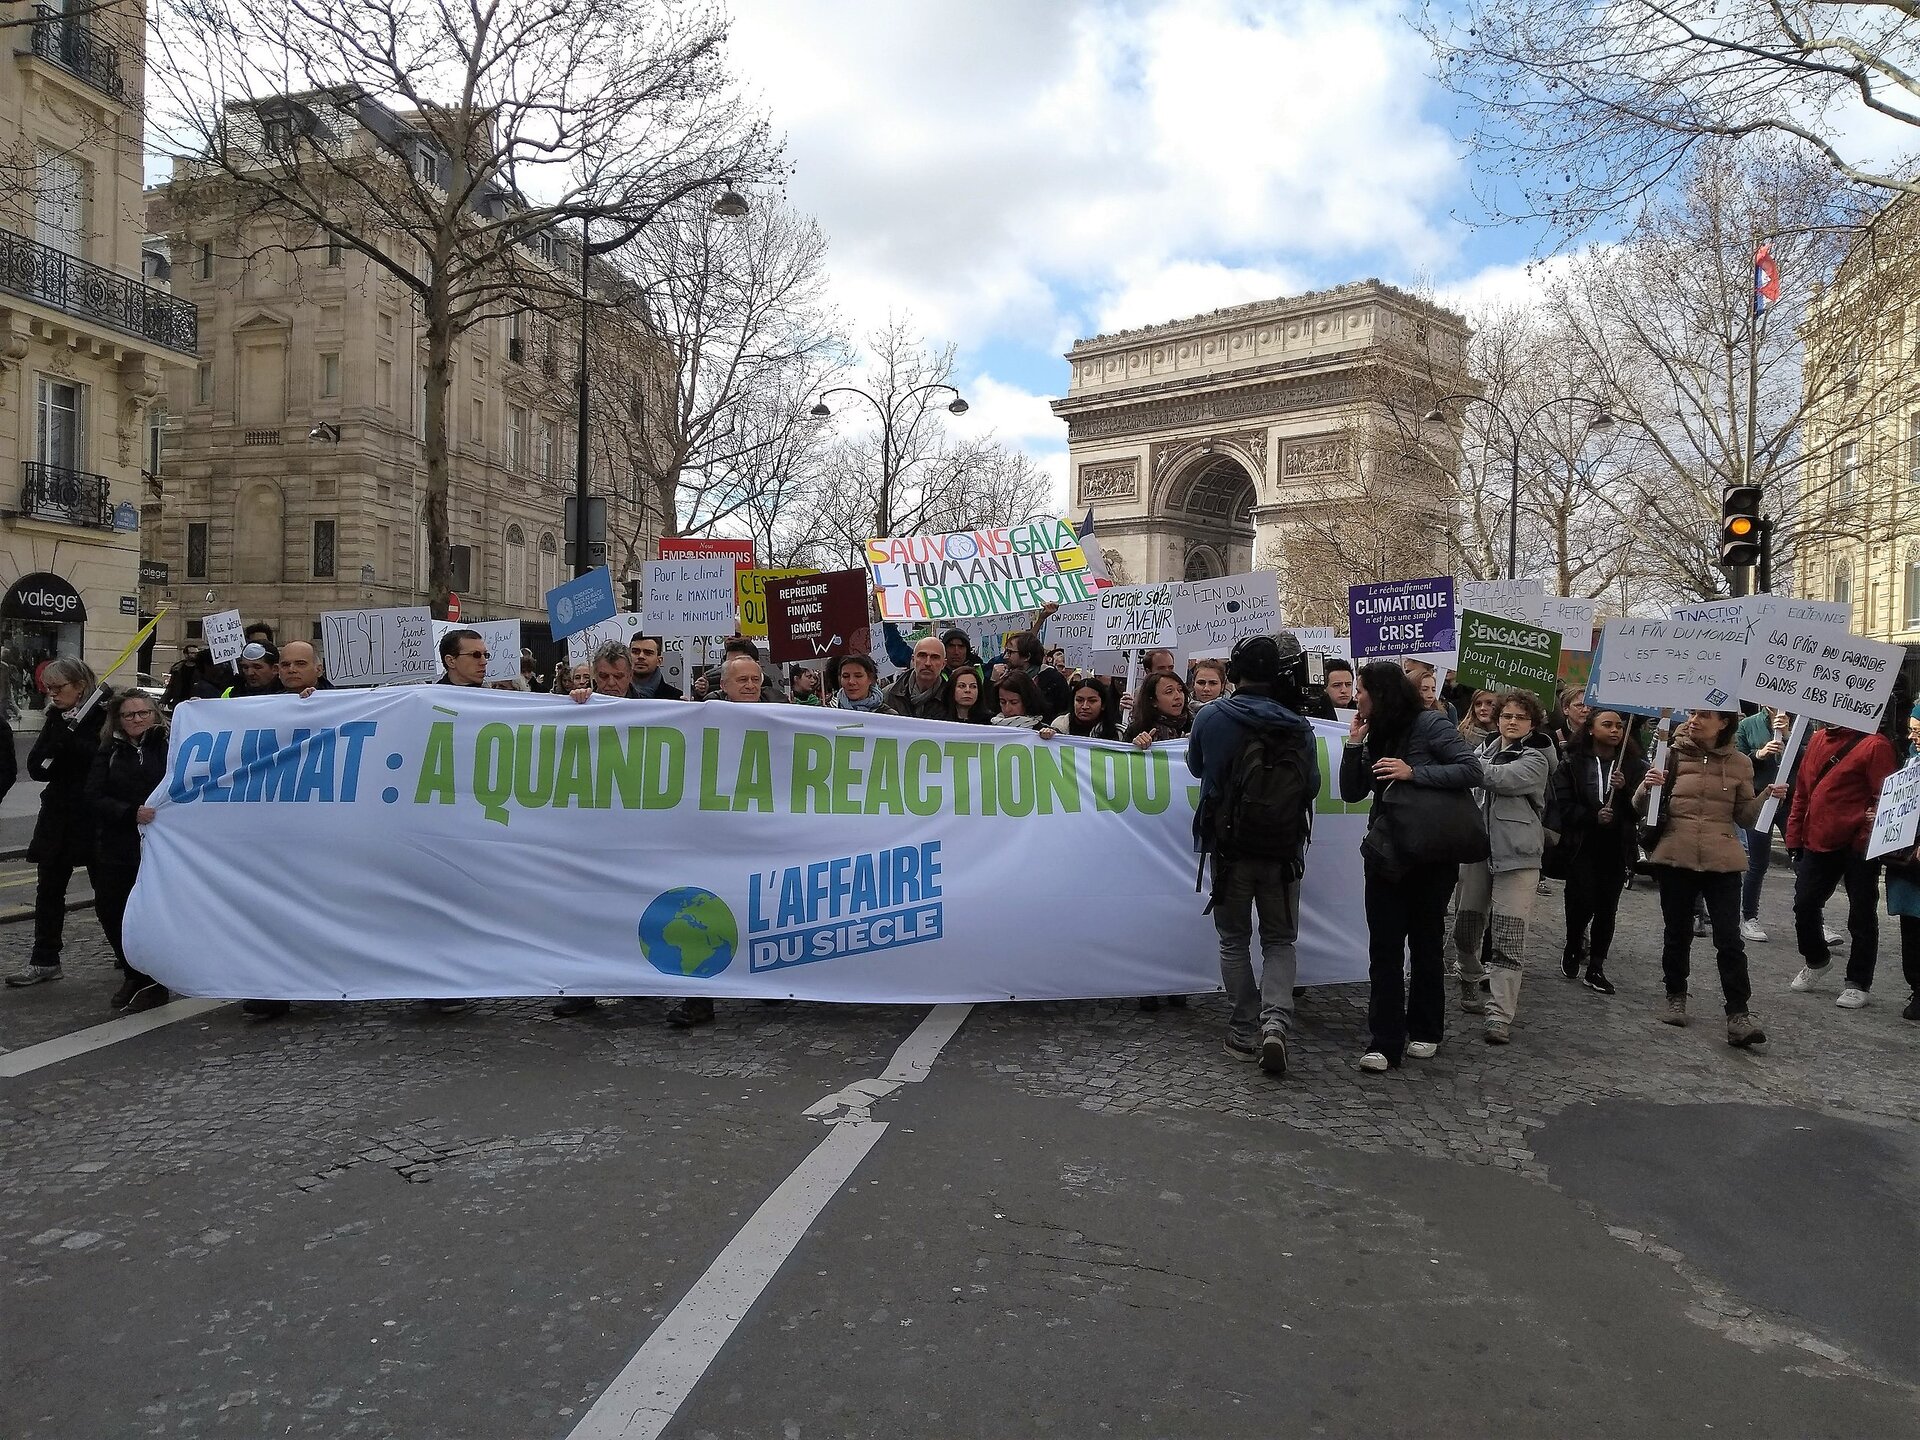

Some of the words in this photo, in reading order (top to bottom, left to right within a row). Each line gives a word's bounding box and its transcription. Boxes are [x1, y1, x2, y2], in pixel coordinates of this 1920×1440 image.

[868, 528, 1012, 564] SAUVONS
[654, 567, 676, 582] Pour
[681, 566, 690, 580] le
[694, 565, 724, 580] climat
[676, 589, 682, 601] le
[779, 583, 828, 599] REPRENDRE
[1193, 583, 1221, 603] FIN
[1226, 584, 1245, 597] DU
[1369, 587, 1378, 595] Le
[1380, 582, 1432, 595] réchauffement
[18, 589, 78, 612] valege
[787, 602, 823, 616] FINANCE
[879, 588, 927, 618] LA
[1101, 589, 1143, 615] énergie
[1214, 595, 1270, 615] MONDE
[1355, 592, 1447, 615] CLIMATIQUE
[668, 610, 674, 620] le
[1051, 613, 1061, 622] ON
[1062, 613, 1088, 622] POUSSE
[1106, 615, 1121, 628] un
[1177, 619, 1201, 635] c'est
[1205, 618, 1227, 636] pas
[1229, 615, 1248, 638] que
[1249, 610, 1275, 621] dans
[1366, 615, 1382, 624] n'est
[1384, 614, 1396, 625] pas
[1413, 610, 1437, 622] simple
[1055, 626, 1087, 638] TROP
[1106, 629, 1160, 650] rayonnant
[1208, 631, 1227, 646] les
[1379, 623, 1424, 641] CRISE
[1468, 618, 1551, 650] S'ENGAGER
[1619, 623, 1635, 636] LA
[1673, 627, 1694, 639] DU
[1695, 628, 1746, 643] MONDE
[325, 612, 398, 680] DIESEL
[399, 640, 421, 656] plus
[407, 650, 420, 658] la
[1365, 645, 1378, 654] que
[1388, 641, 1409, 652] temps
[1411, 639, 1440, 651] effacera
[1665, 649, 1690, 660] PAS
[1696, 650, 1722, 661] QUE
[1768, 629, 1788, 646] LA
[1821, 645, 1840, 660] DU
[1841, 650, 1887, 673] MONDE
[401, 660, 434, 672] ROUTE
[1462, 647, 1492, 663] pour
[1495, 652, 1506, 669] la
[1507, 659, 1554, 683] planète
[1765, 653, 1807, 673] C'EST
[1812, 664, 1841, 682] PAS
[1845, 674, 1877, 692] QUE
[1608, 671, 1641, 683] DANS
[1646, 673, 1669, 684] LES
[1755, 672, 1798, 694] DANS
[1802, 687, 1828, 704] LES
[170, 721, 377, 804] CLIMAT
[414, 705, 459, 806] À
[473, 722, 687, 827] QUAND
[699, 728, 775, 815] LA
[790, 722, 1085, 818] RÉACTION
[1090, 747, 1171, 815] DU
[749, 840, 943, 934] L'AFFAIRE
[754, 936, 804, 968] DU
[812, 908, 939, 956] SIÈCLE
